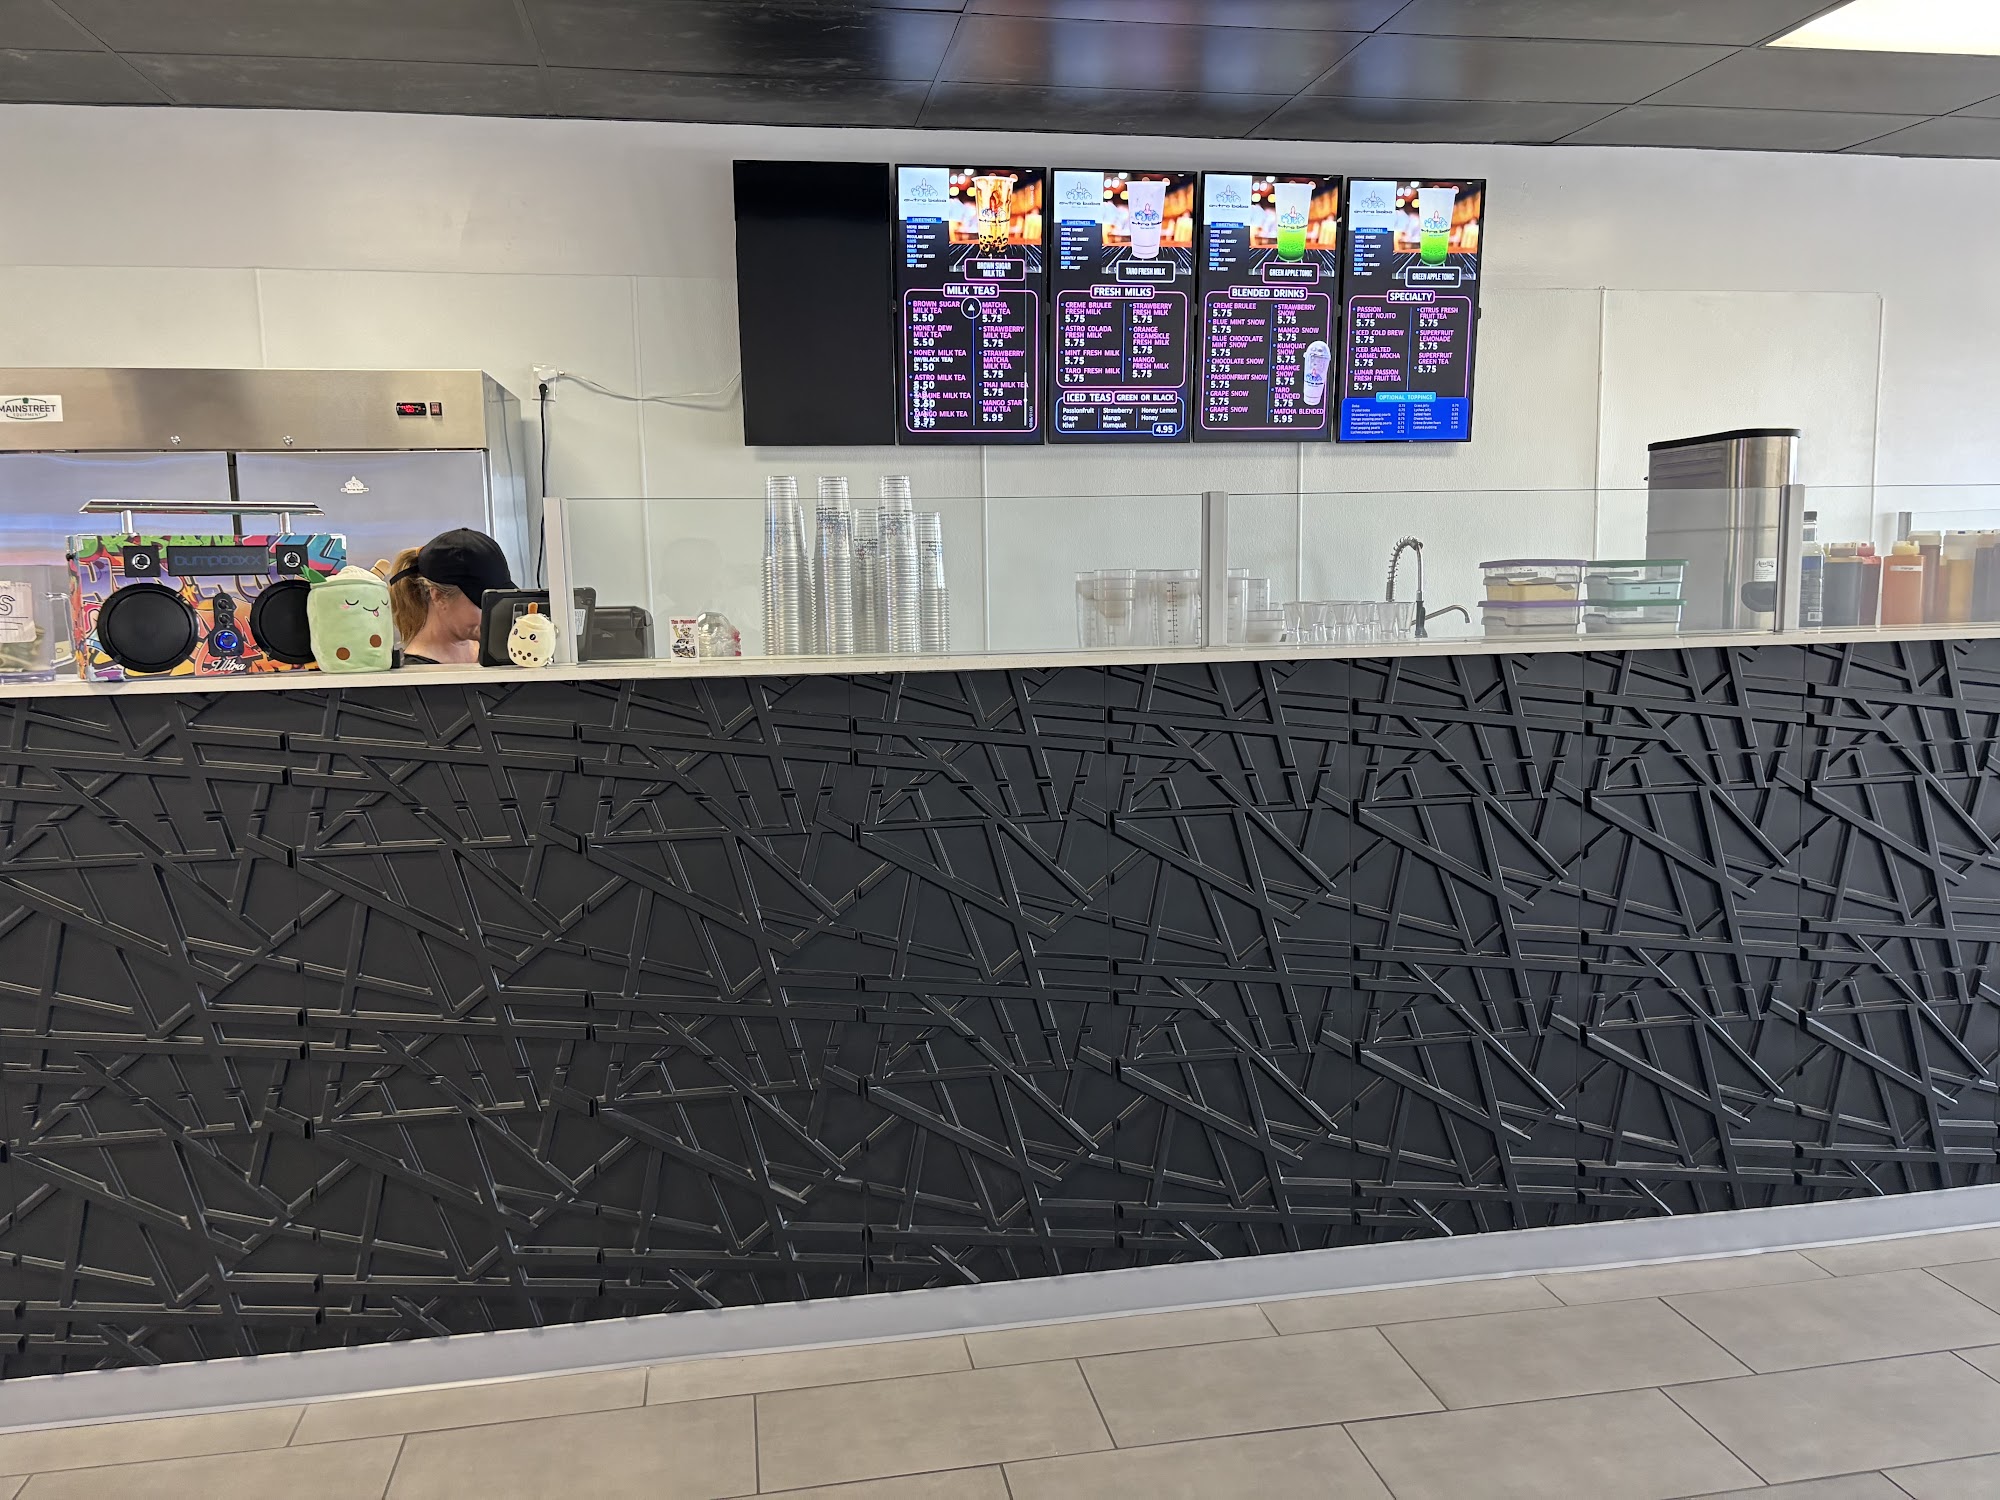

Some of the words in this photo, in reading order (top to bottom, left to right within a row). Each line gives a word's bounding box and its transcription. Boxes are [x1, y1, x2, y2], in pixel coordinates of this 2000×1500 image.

[947, 286, 969, 294] MILK
[973, 287, 995, 295] TEAS
[1125, 288, 1151, 296] MILKS
[1232, 289, 1270, 297] BLENDED
[1274, 289, 1304, 298] DRINKS
[212, 659, 246, 671] Ultra
